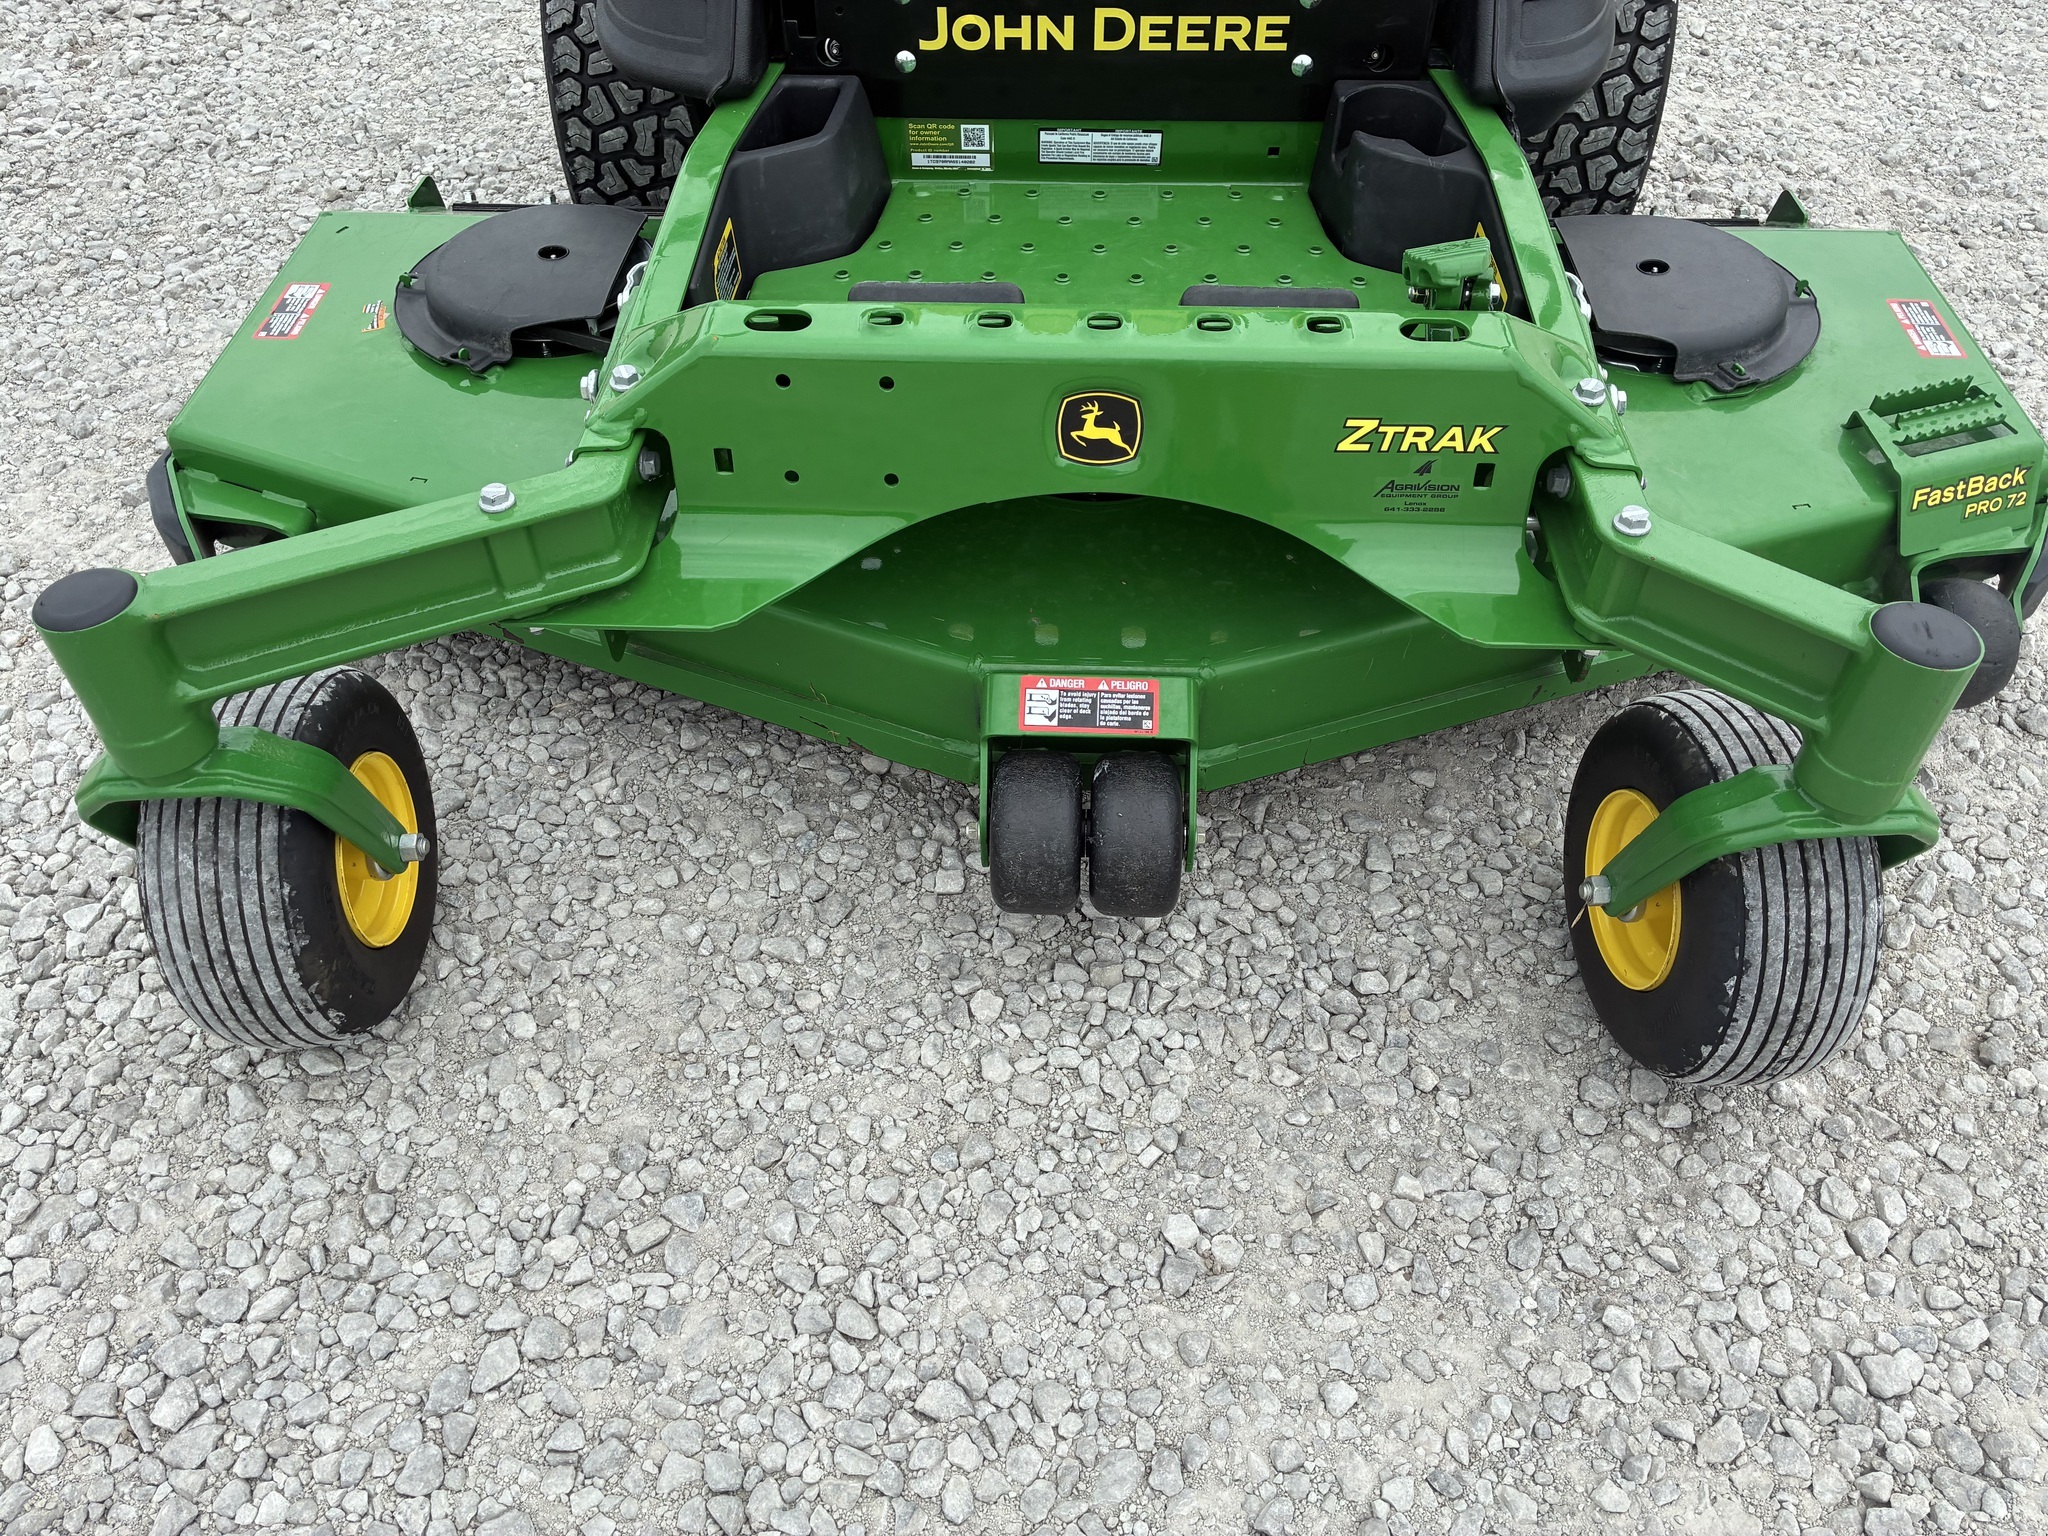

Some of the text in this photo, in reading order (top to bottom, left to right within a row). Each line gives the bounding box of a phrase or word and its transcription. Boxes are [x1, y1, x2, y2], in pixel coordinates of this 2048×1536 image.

[918, 6, 1290, 52] JOHN DEERE
[1911, 465, 2030, 511] FastBack
[1964, 491, 2027, 518] PRO 72
[1049, 679, 1148, 690] DANGER PELIGRO
